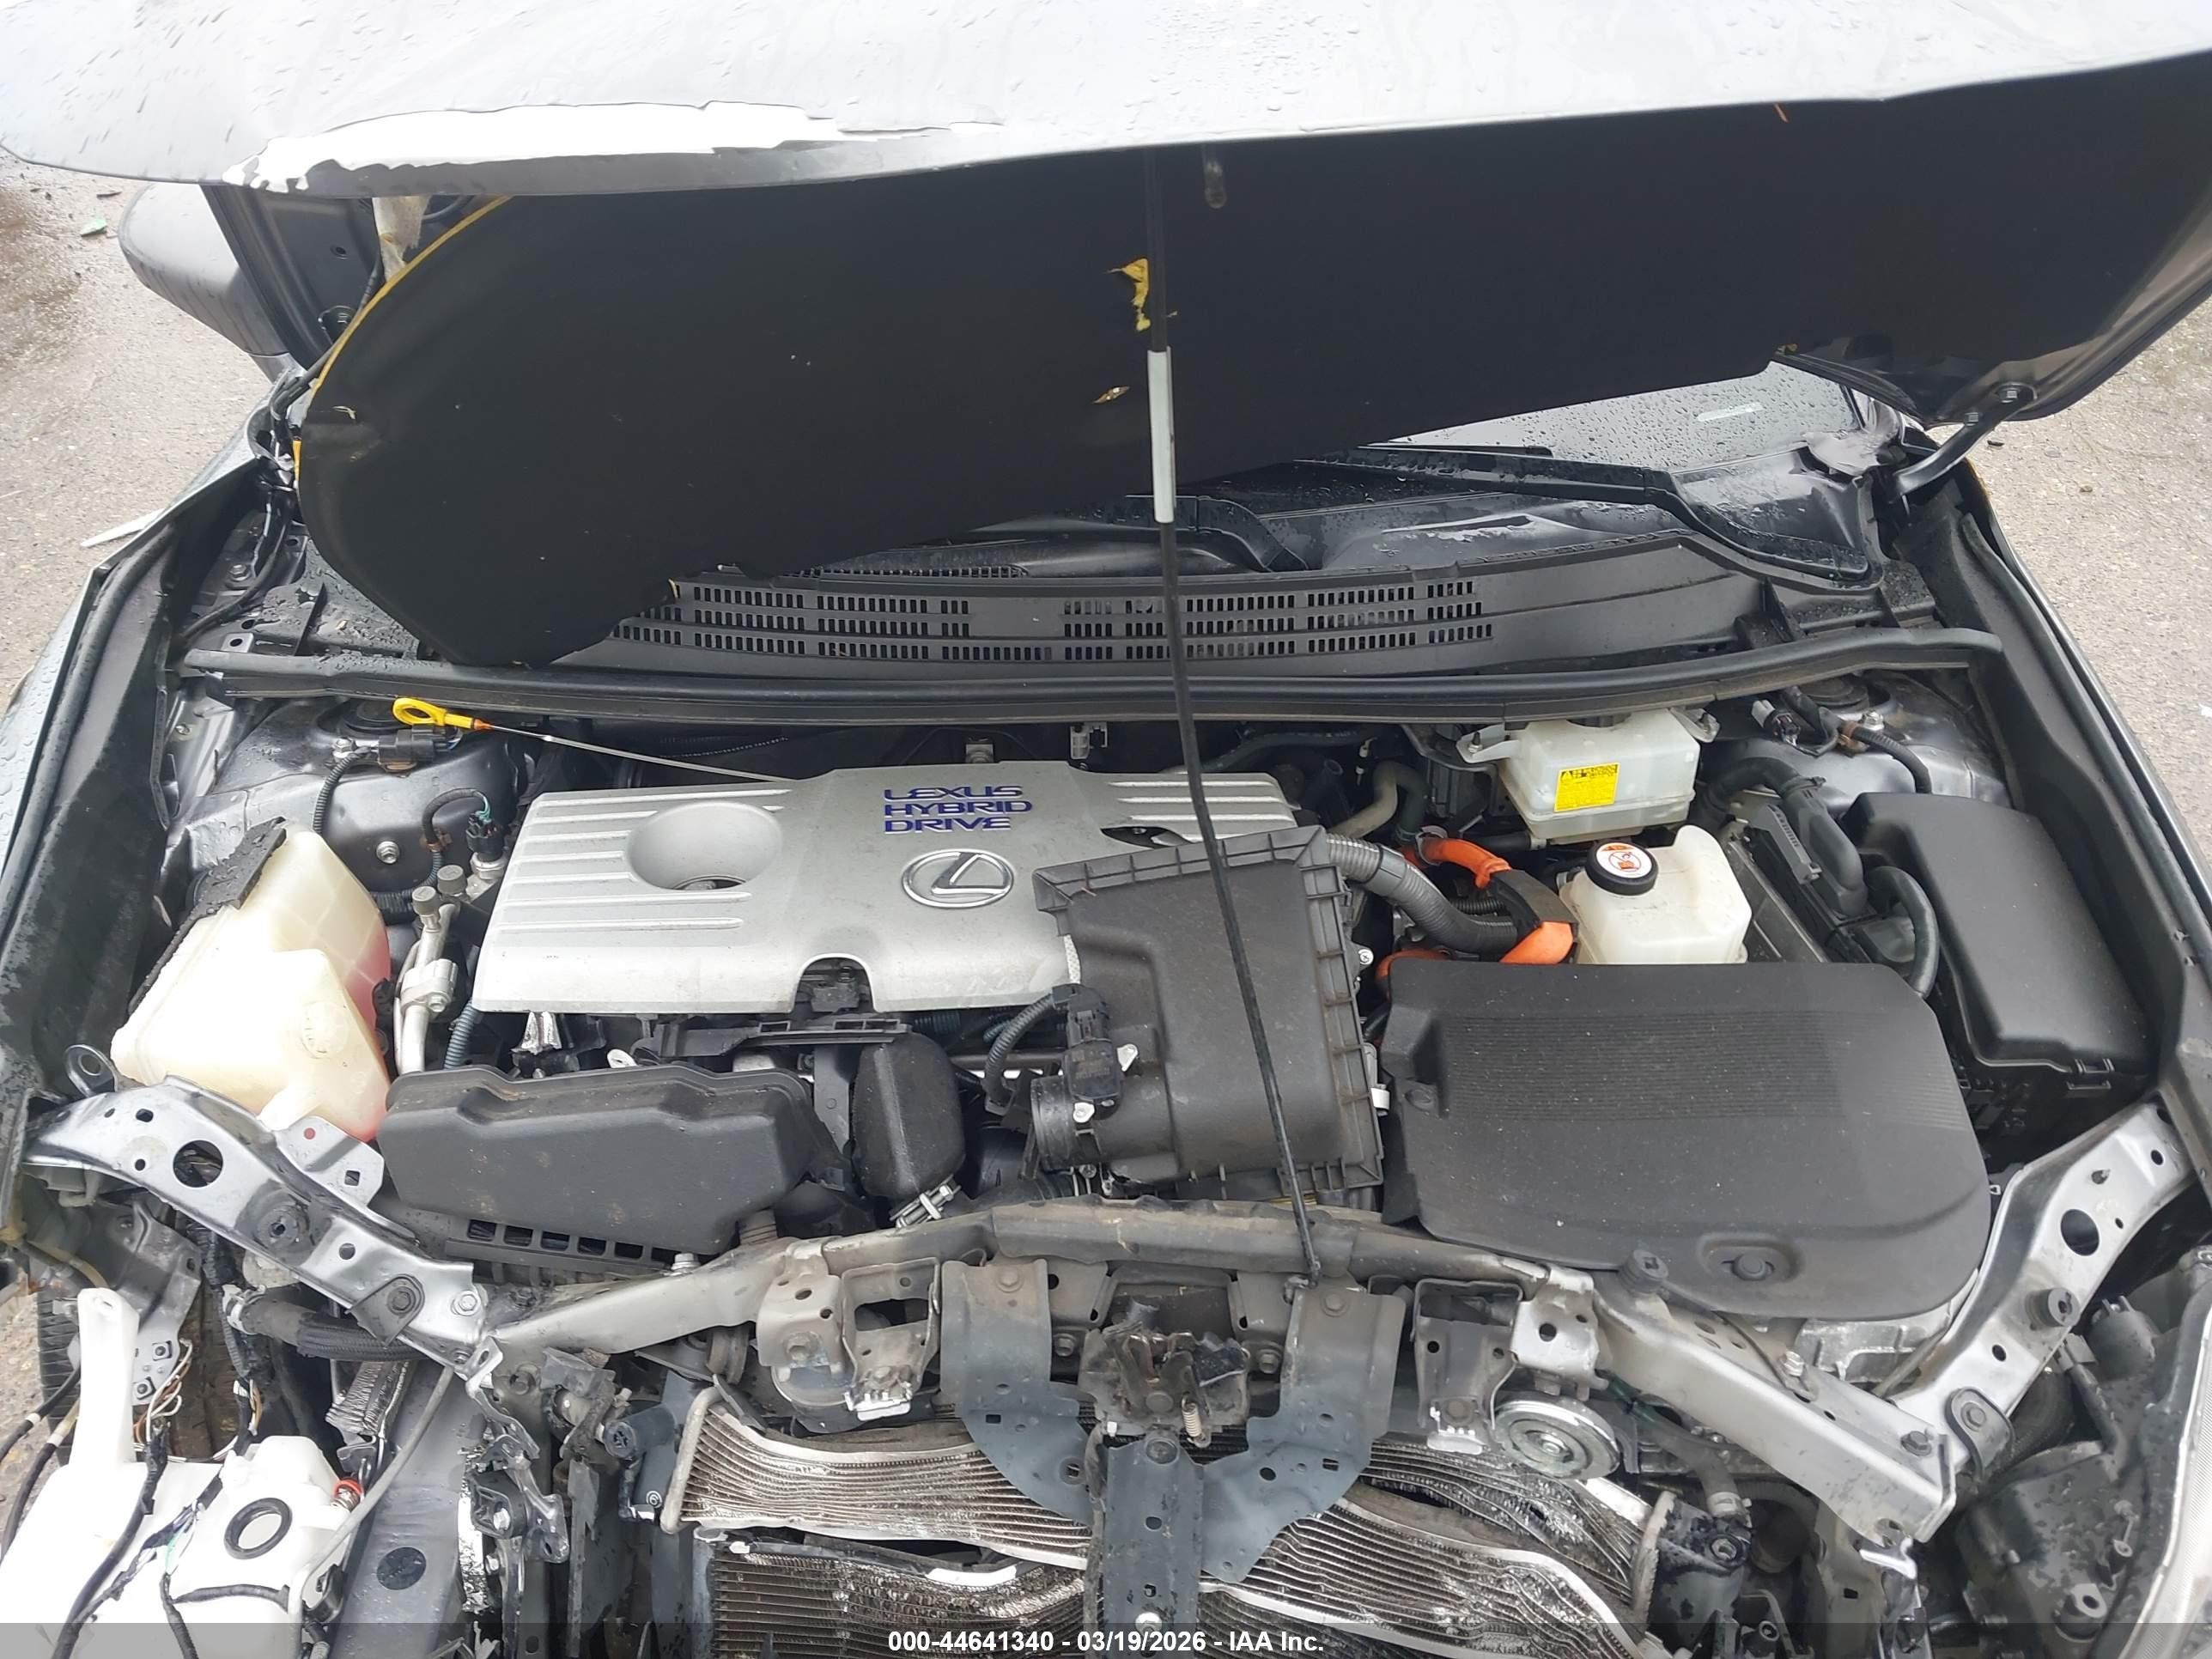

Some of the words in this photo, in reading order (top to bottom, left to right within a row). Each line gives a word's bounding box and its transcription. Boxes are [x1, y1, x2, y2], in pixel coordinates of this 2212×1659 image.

[884, 786, 1024, 800] LEXUS
[884, 800, 1033, 817] HYBRID
[884, 817, 1012, 833] DRIVE
